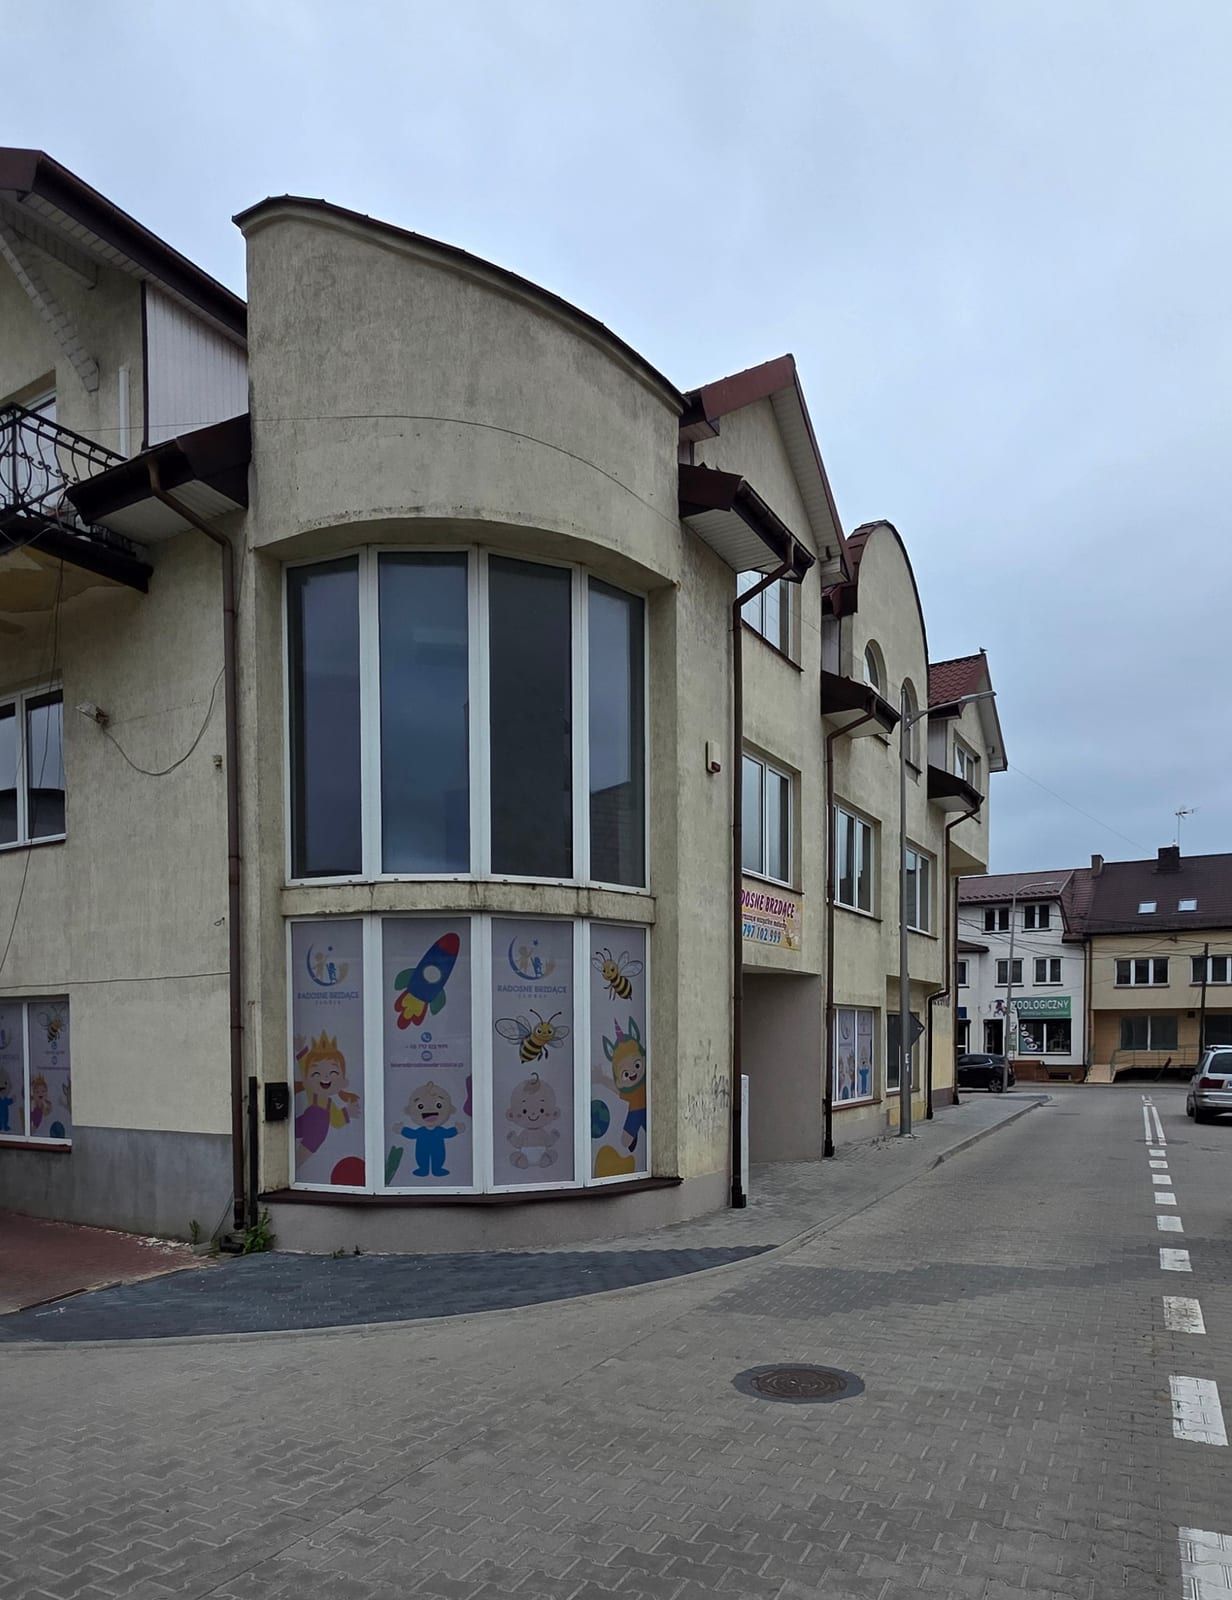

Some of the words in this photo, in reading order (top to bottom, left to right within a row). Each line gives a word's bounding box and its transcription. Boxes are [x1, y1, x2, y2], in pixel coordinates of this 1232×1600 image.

[739, 889, 764, 911] DOSNE
[765, 896, 795, 922] BRZDĄCE
[743, 923, 755, 938] 797
